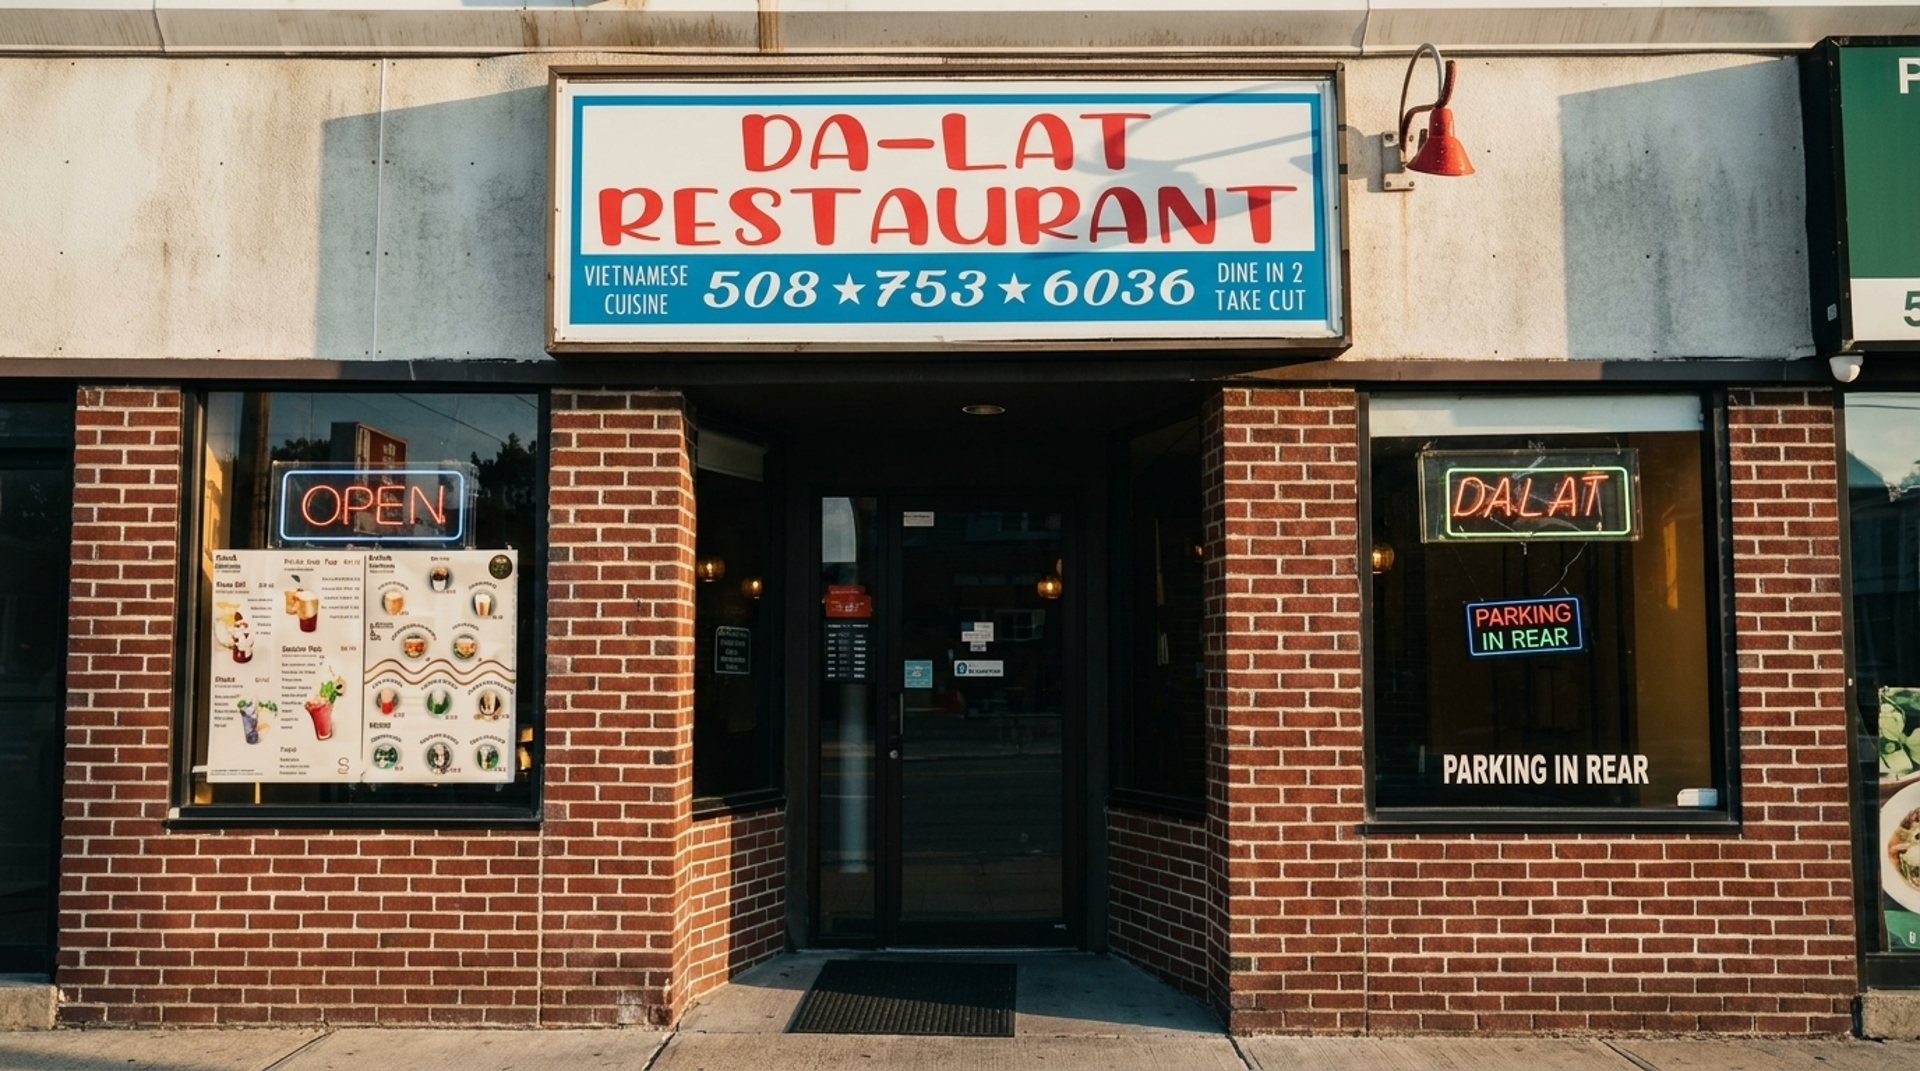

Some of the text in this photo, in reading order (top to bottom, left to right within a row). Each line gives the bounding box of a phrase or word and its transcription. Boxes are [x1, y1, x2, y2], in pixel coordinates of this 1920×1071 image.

[742, 113, 1151, 172] DA-LAT
[599, 185, 1298, 248] RESTAURANT
[584, 265, 689, 287] VIETNAMESE
[1217, 261, 1303, 283] DINE IN 2
[703, 270, 1195, 308] 508 753 6036
[1215, 289, 1306, 311] TAKE CUT
[604, 294, 669, 315] CUISINE
[301, 484, 447, 527] OPEN
[1452, 474, 1610, 518] DALAT
[1475, 602, 1572, 628] PARKING
[1482, 627, 1570, 651] IN REAR
[1443, 754, 1650, 785] PARKING IN REAR
